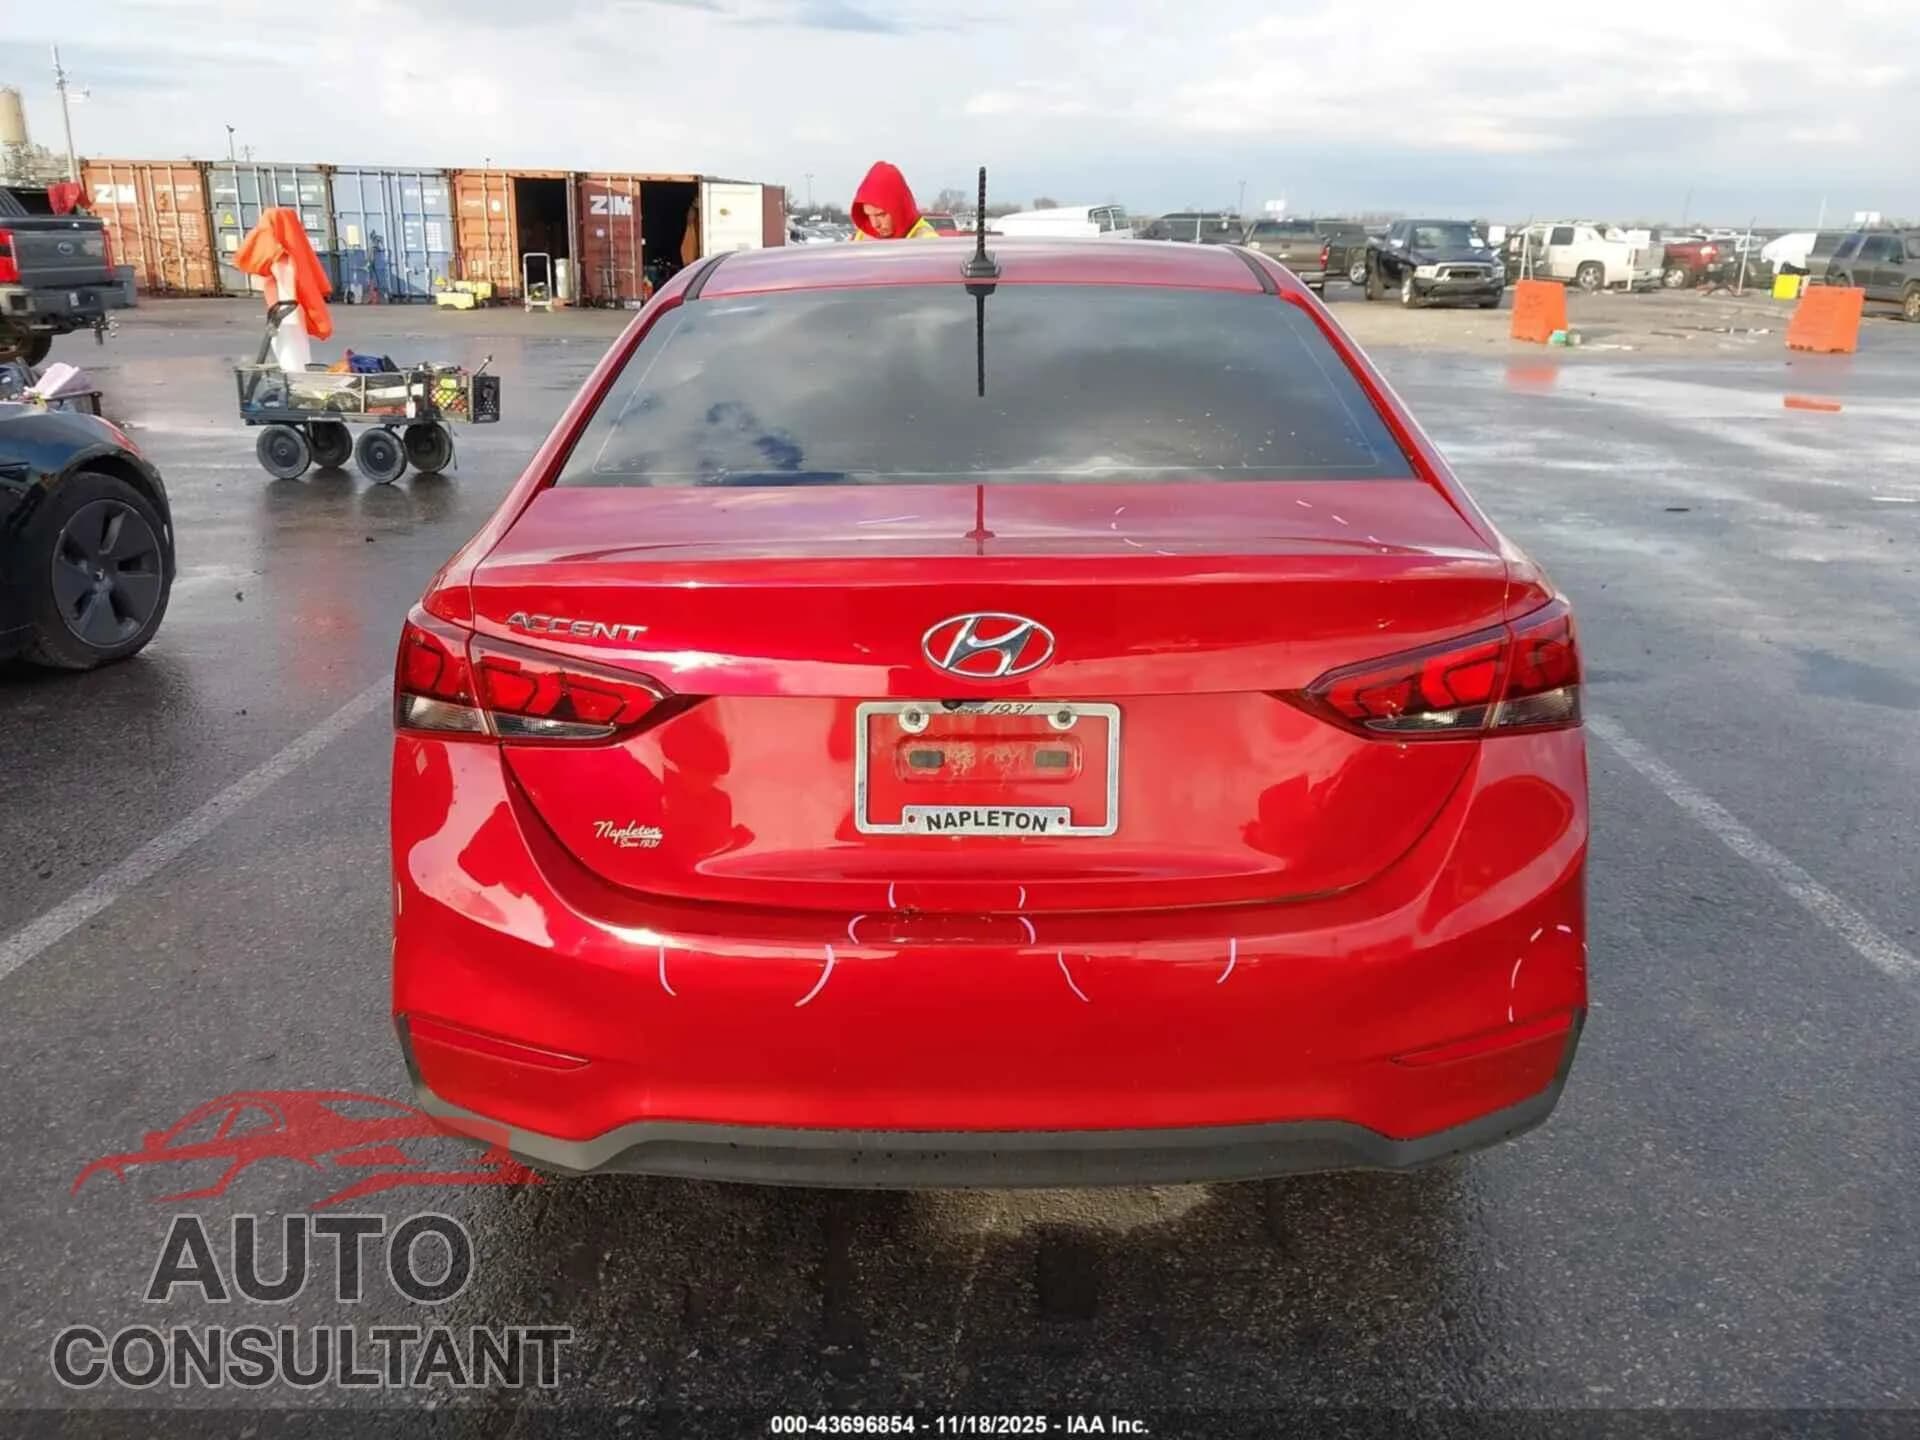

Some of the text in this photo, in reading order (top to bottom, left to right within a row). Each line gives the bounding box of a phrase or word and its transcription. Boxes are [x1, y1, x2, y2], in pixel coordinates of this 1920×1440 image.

[590, 195, 632, 215] ZIM
[506, 611, 648, 641] ACCENT
[593, 819, 663, 844] Napleton
[926, 811, 1049, 832] NAPLETON
